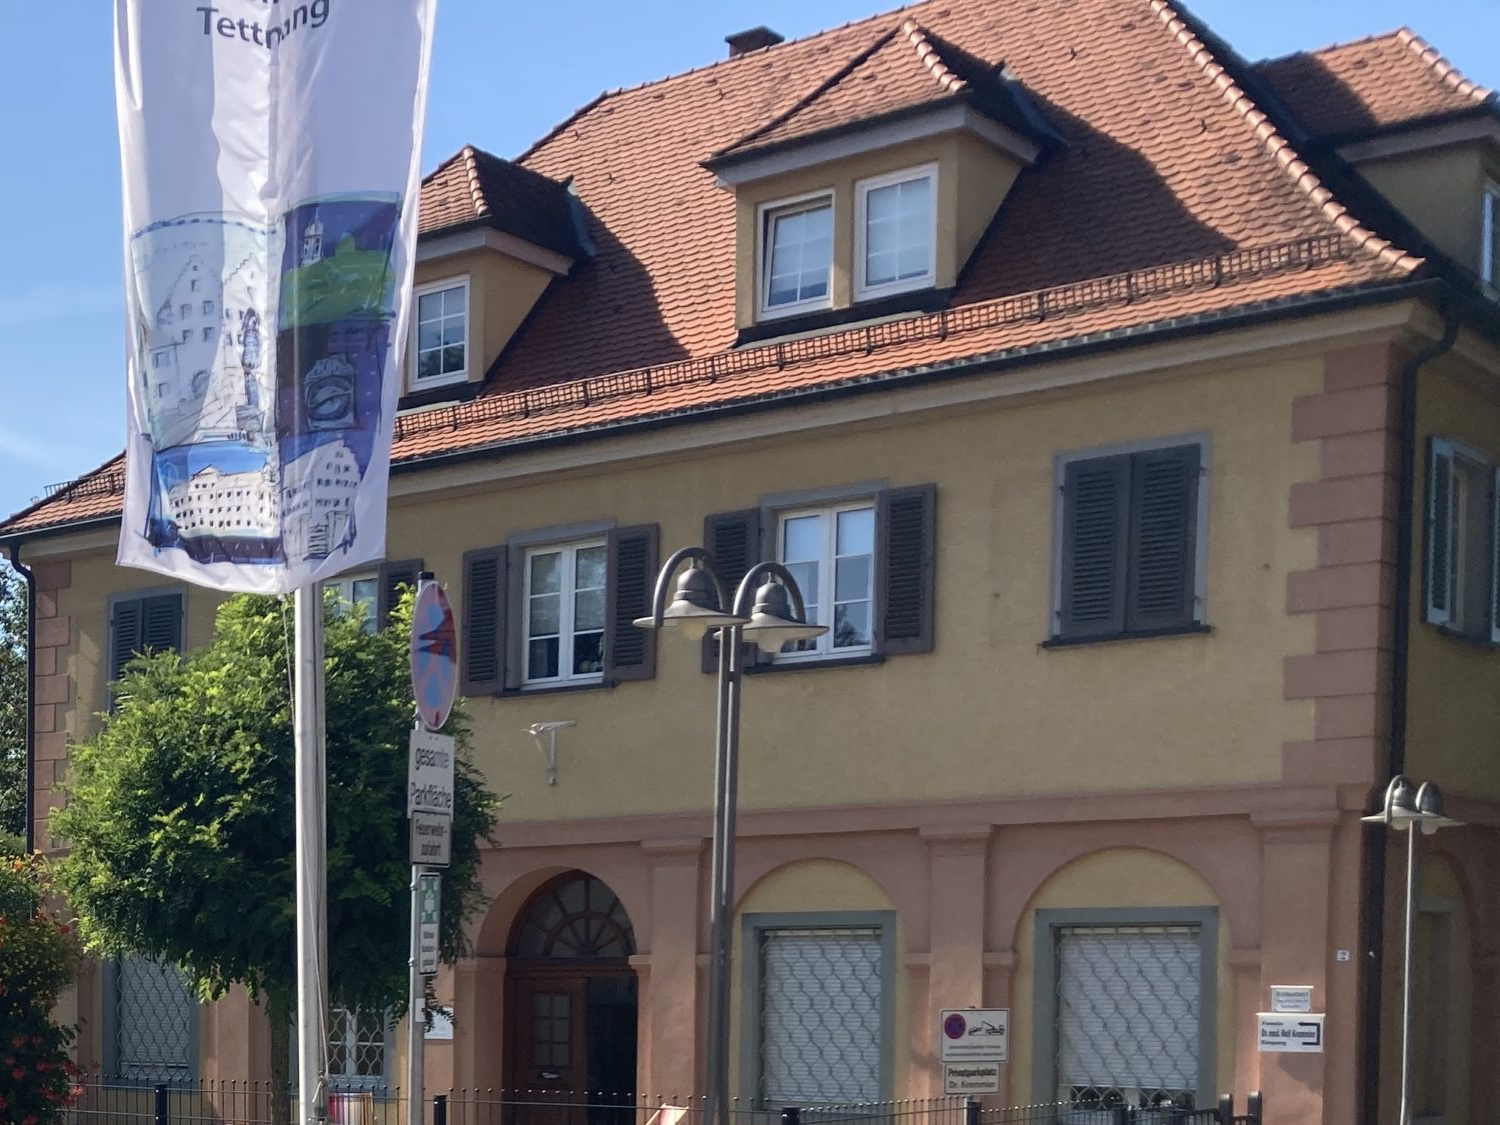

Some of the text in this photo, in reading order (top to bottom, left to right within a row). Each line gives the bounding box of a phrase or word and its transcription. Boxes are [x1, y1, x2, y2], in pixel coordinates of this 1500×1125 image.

[415, 747, 449, 770] gesamte
[410, 782, 452, 809] Parkfläche
[948, 1067, 997, 1079] Privatparkplatz
